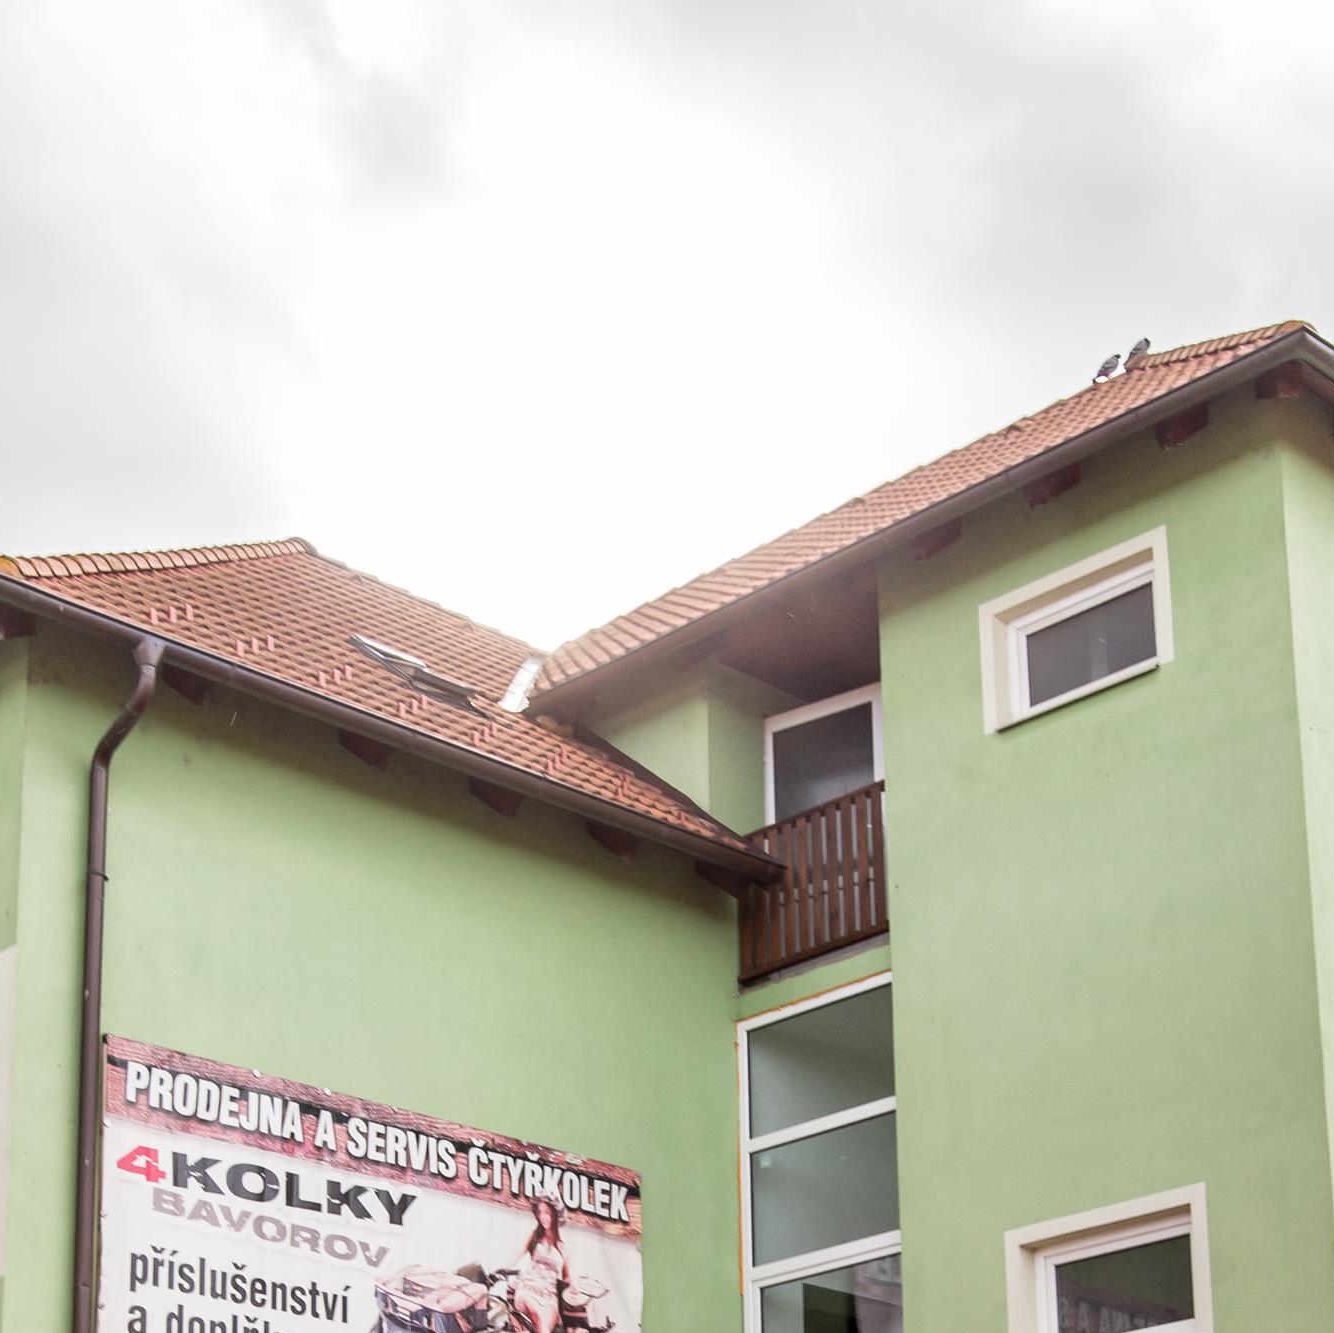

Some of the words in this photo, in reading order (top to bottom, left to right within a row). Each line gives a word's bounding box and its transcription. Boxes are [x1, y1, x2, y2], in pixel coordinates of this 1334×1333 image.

[125, 1061, 303, 1143] PRODEJNA
[314, 1116, 338, 1151] A
[348, 1117, 457, 1178] SERVIS
[469, 1139, 630, 1222] ČTYŘKOLEK
[116, 1144, 418, 1226] 4KOLKY
[152, 1183, 390, 1267] BAVOROV
[130, 1245, 351, 1323] příslušenství
